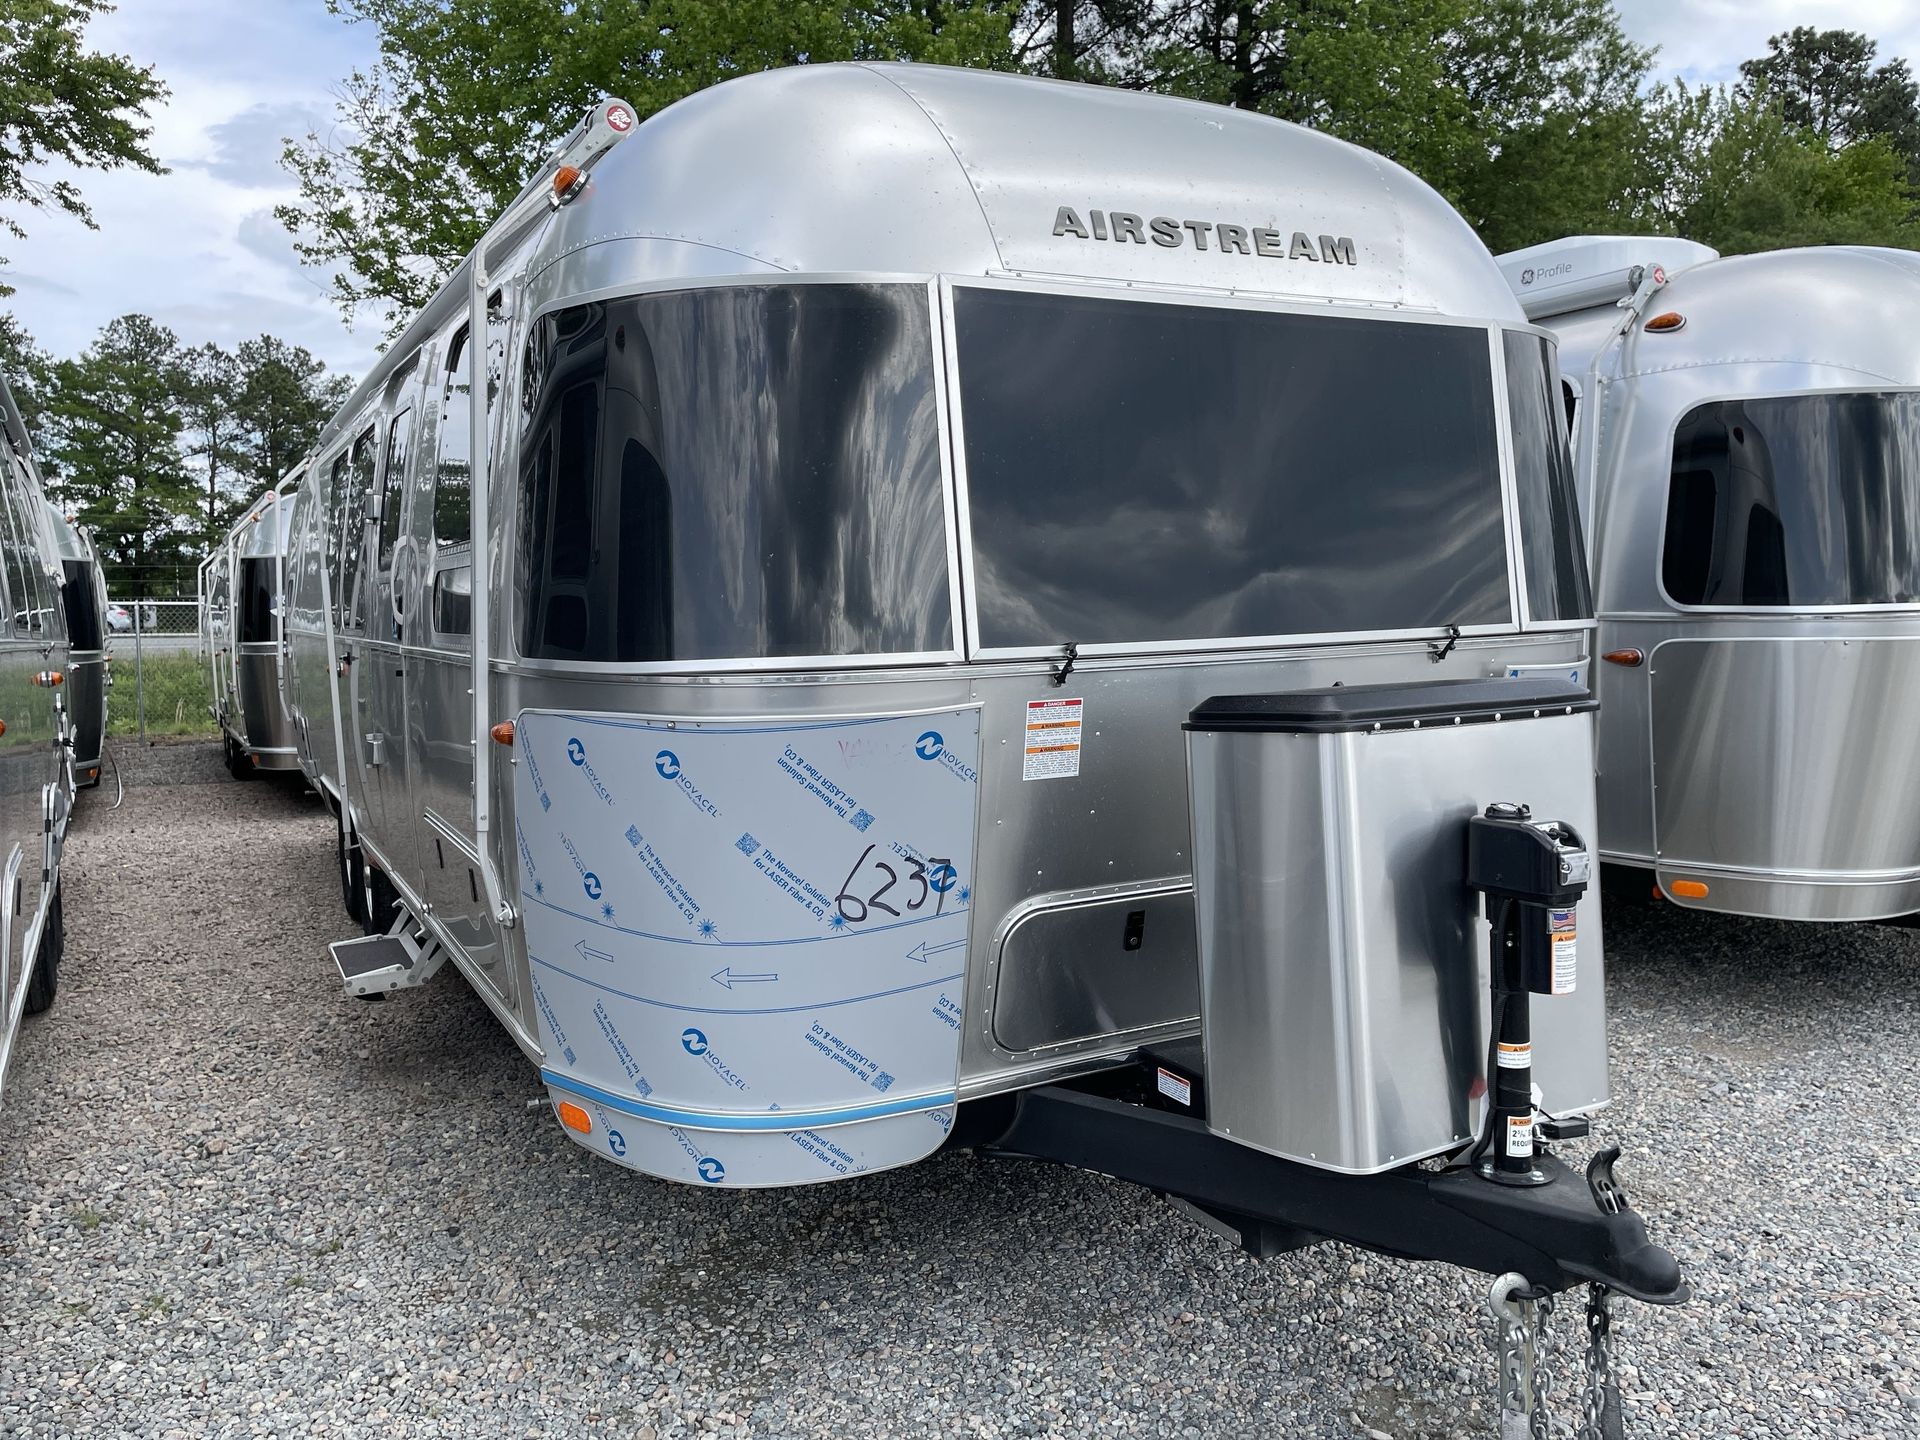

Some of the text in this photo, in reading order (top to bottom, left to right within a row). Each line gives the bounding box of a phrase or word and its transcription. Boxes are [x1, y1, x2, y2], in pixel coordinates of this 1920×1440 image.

[1052, 206, 1357, 265] AIRSTREAM
[1536, 263, 1572, 280] Profile
[796, 757, 804, 766] &
[803, 763, 823, 782] Fiber
[584, 761, 614, 806] NOVACEL
[777, 757, 848, 819] The Novacel Solution
[821, 778, 846, 801] LASER
[678, 774, 718, 818] NOVACEL
[844, 797, 857, 809] for
[638, 851, 647, 863] for
[646, 861, 665, 886] LASER
[664, 884, 679, 904] Fiber
[678, 902, 685, 910] &
[644, 843, 700, 913] The Novacel Solution
[753, 858, 765, 870] for
[764, 867, 789, 890] LASER
[787, 886, 806, 904] Fiber
[805, 901, 812, 909] &
[762, 849, 832, 908] The Novacel Solution
[835, 844, 951, 922] 6237
[932, 1006, 957, 1028] Solution
[949, 1003, 956, 1011] &
[606, 1020, 619, 1039] Fiber
[823, 1031, 831, 1040] &
[592, 1008, 635, 1080] The Novacel Solution
[617, 1039, 633, 1064] LASER
[829, 1036, 848, 1052] Fiber
[632, 1062, 640, 1074] for
[804, 1032, 870, 1082] The Novacel Solution
[846, 1047, 869, 1067] LASER
[867, 1062, 879, 1073] for
[705, 1050, 746, 1091] NOVACEL
[791, 1132, 815, 1153] LASER
[812, 1148, 831, 1164] Fiber
[829, 1159, 837, 1168] &
[827, 1143, 854, 1165] Solution
